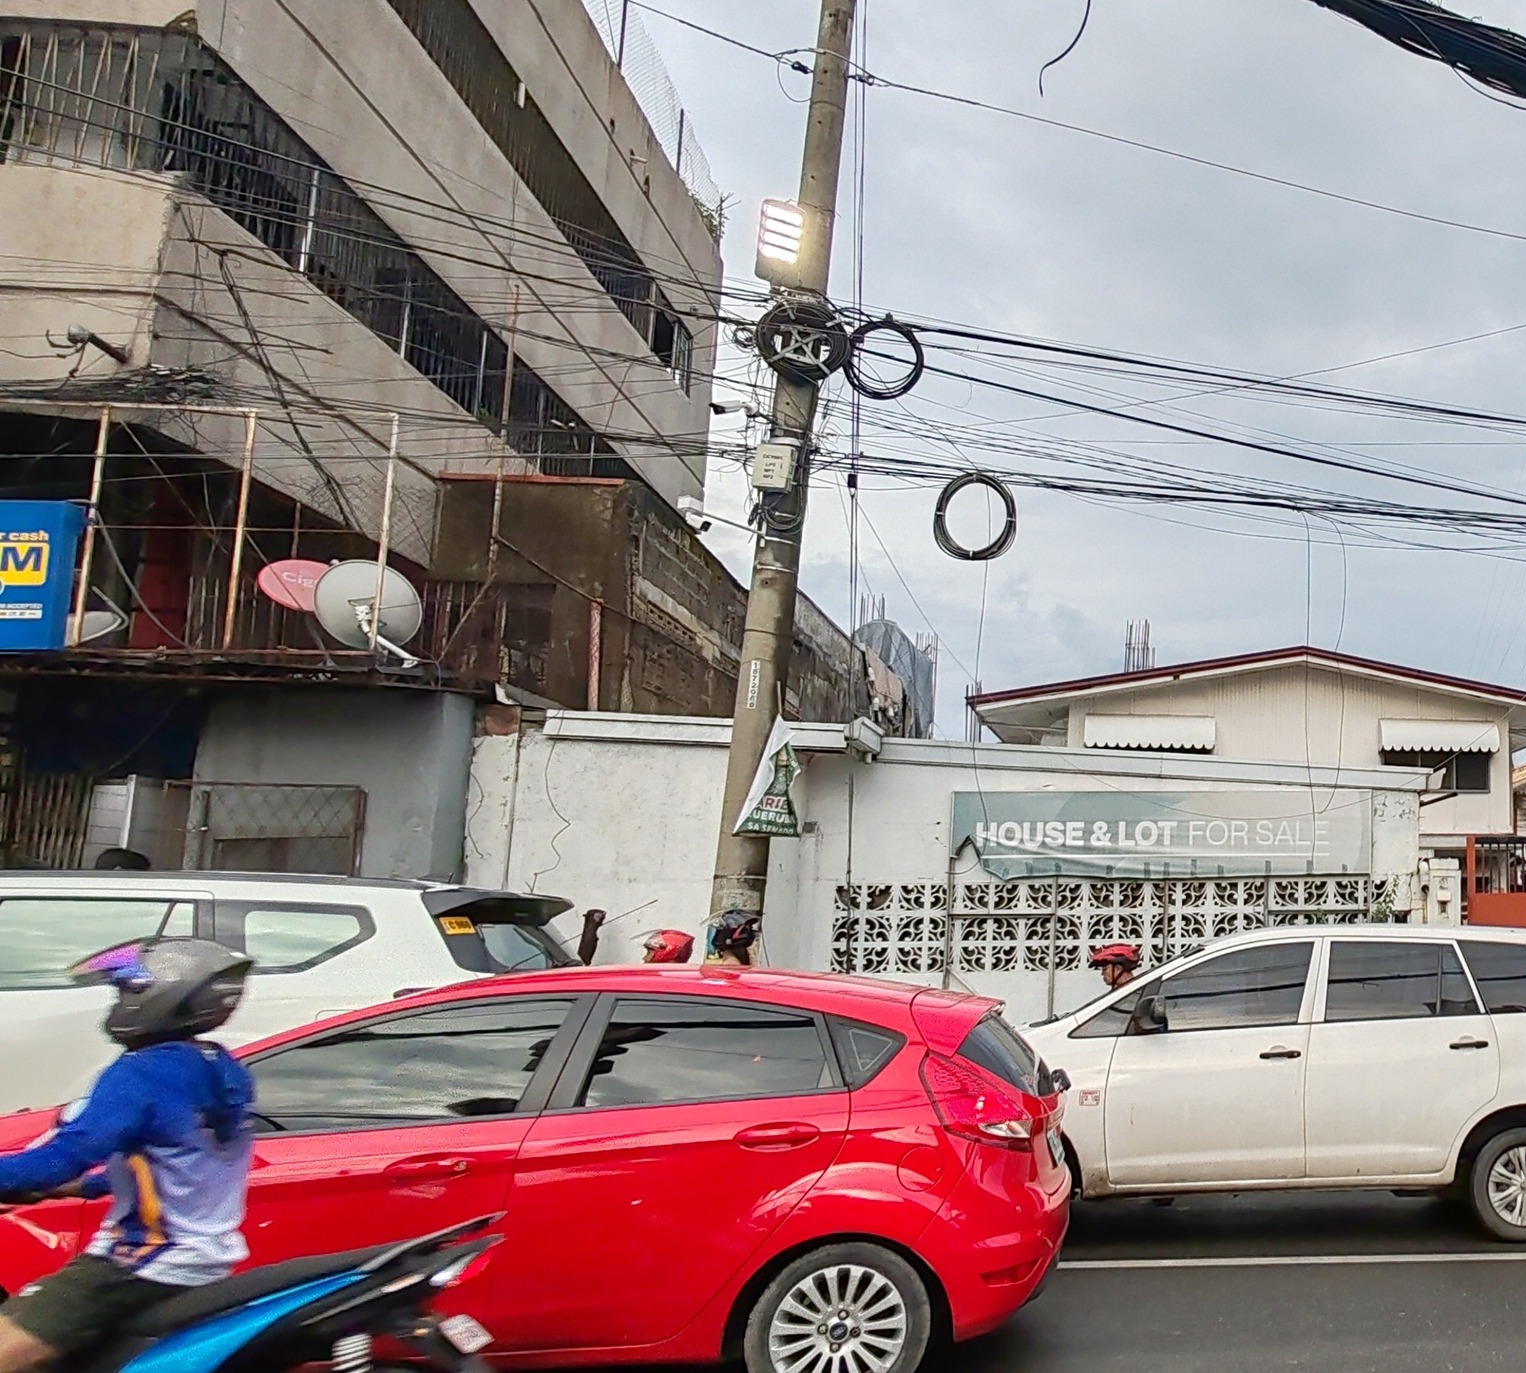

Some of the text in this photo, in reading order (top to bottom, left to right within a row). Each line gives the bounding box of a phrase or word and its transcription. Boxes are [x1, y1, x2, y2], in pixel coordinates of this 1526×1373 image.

[9, 530, 49, 541] cash
[747, 822, 759, 830] SA
[975, 820, 1330, 847] HOUSE & LOT FOR SALE
